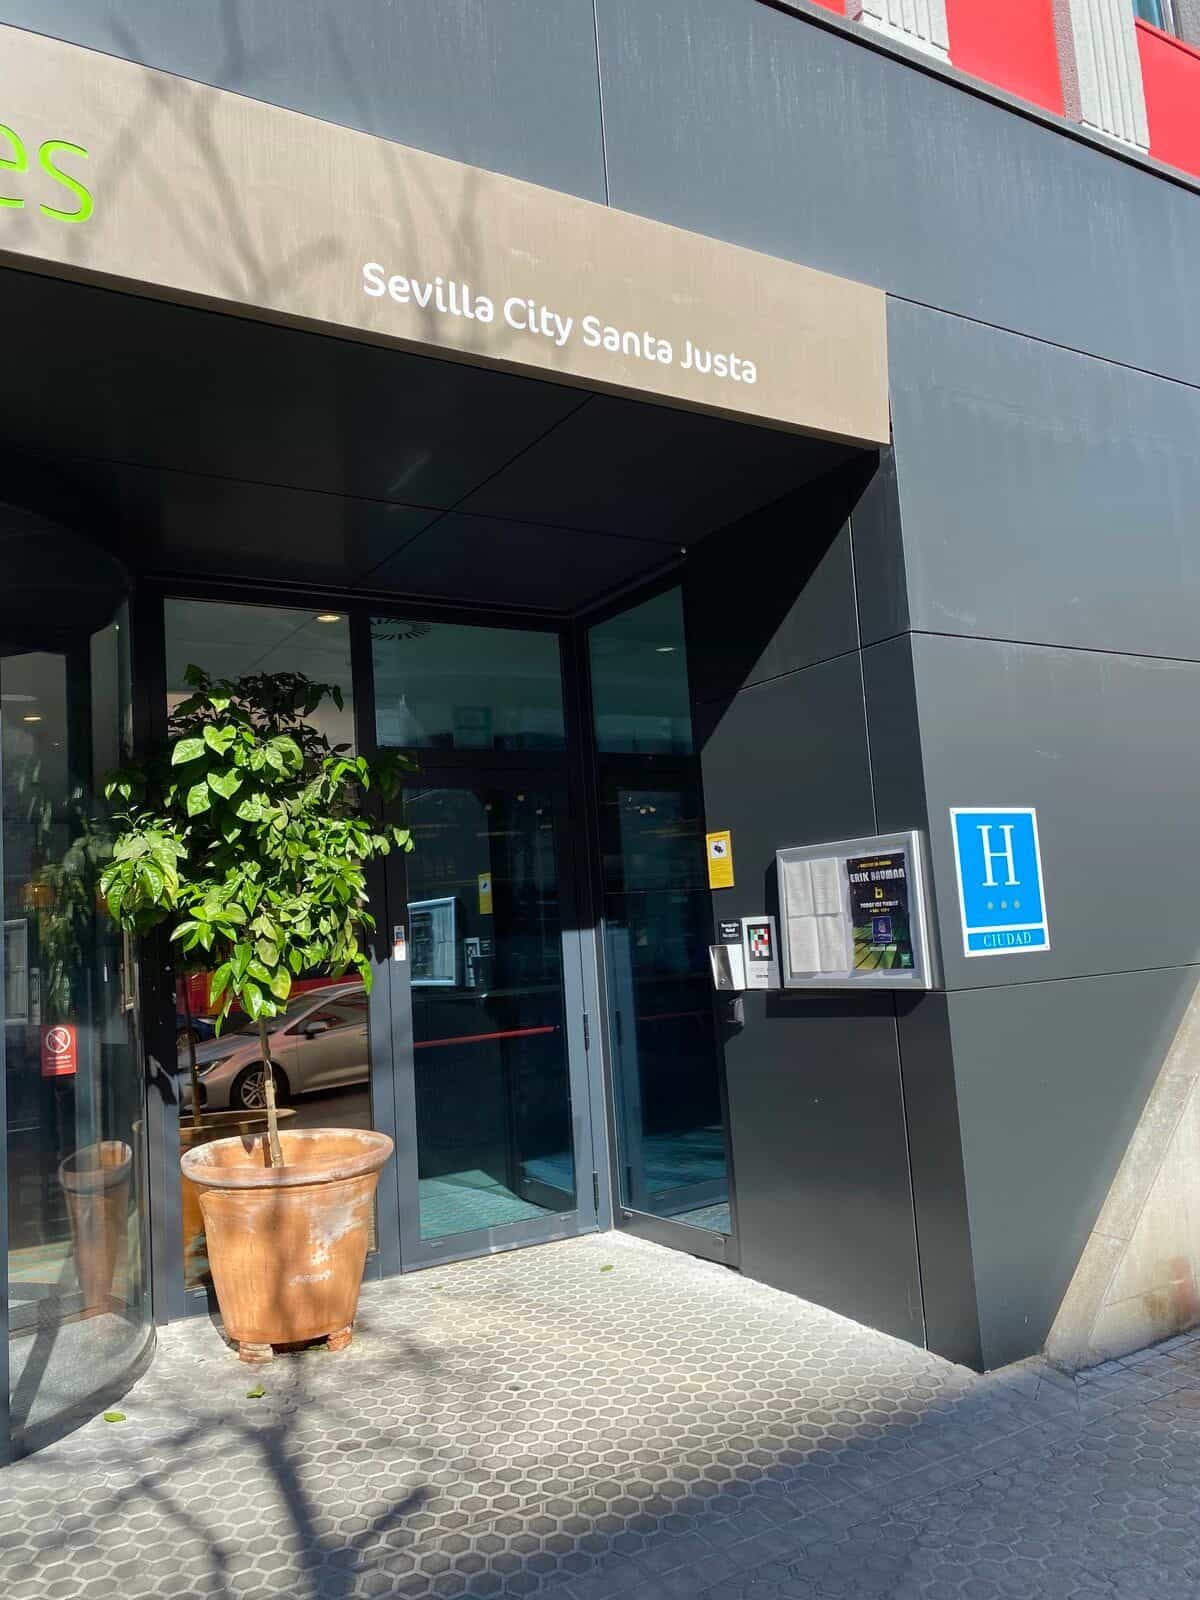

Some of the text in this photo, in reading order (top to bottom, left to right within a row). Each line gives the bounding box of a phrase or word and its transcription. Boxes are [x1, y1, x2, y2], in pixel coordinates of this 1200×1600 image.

[362, 262, 758, 384] Sevilla City Santa Justa
[976, 824, 1021, 886] H
[850, 872, 870, 883] ERIK
[983, 931, 1032, 948] CIUDAD
